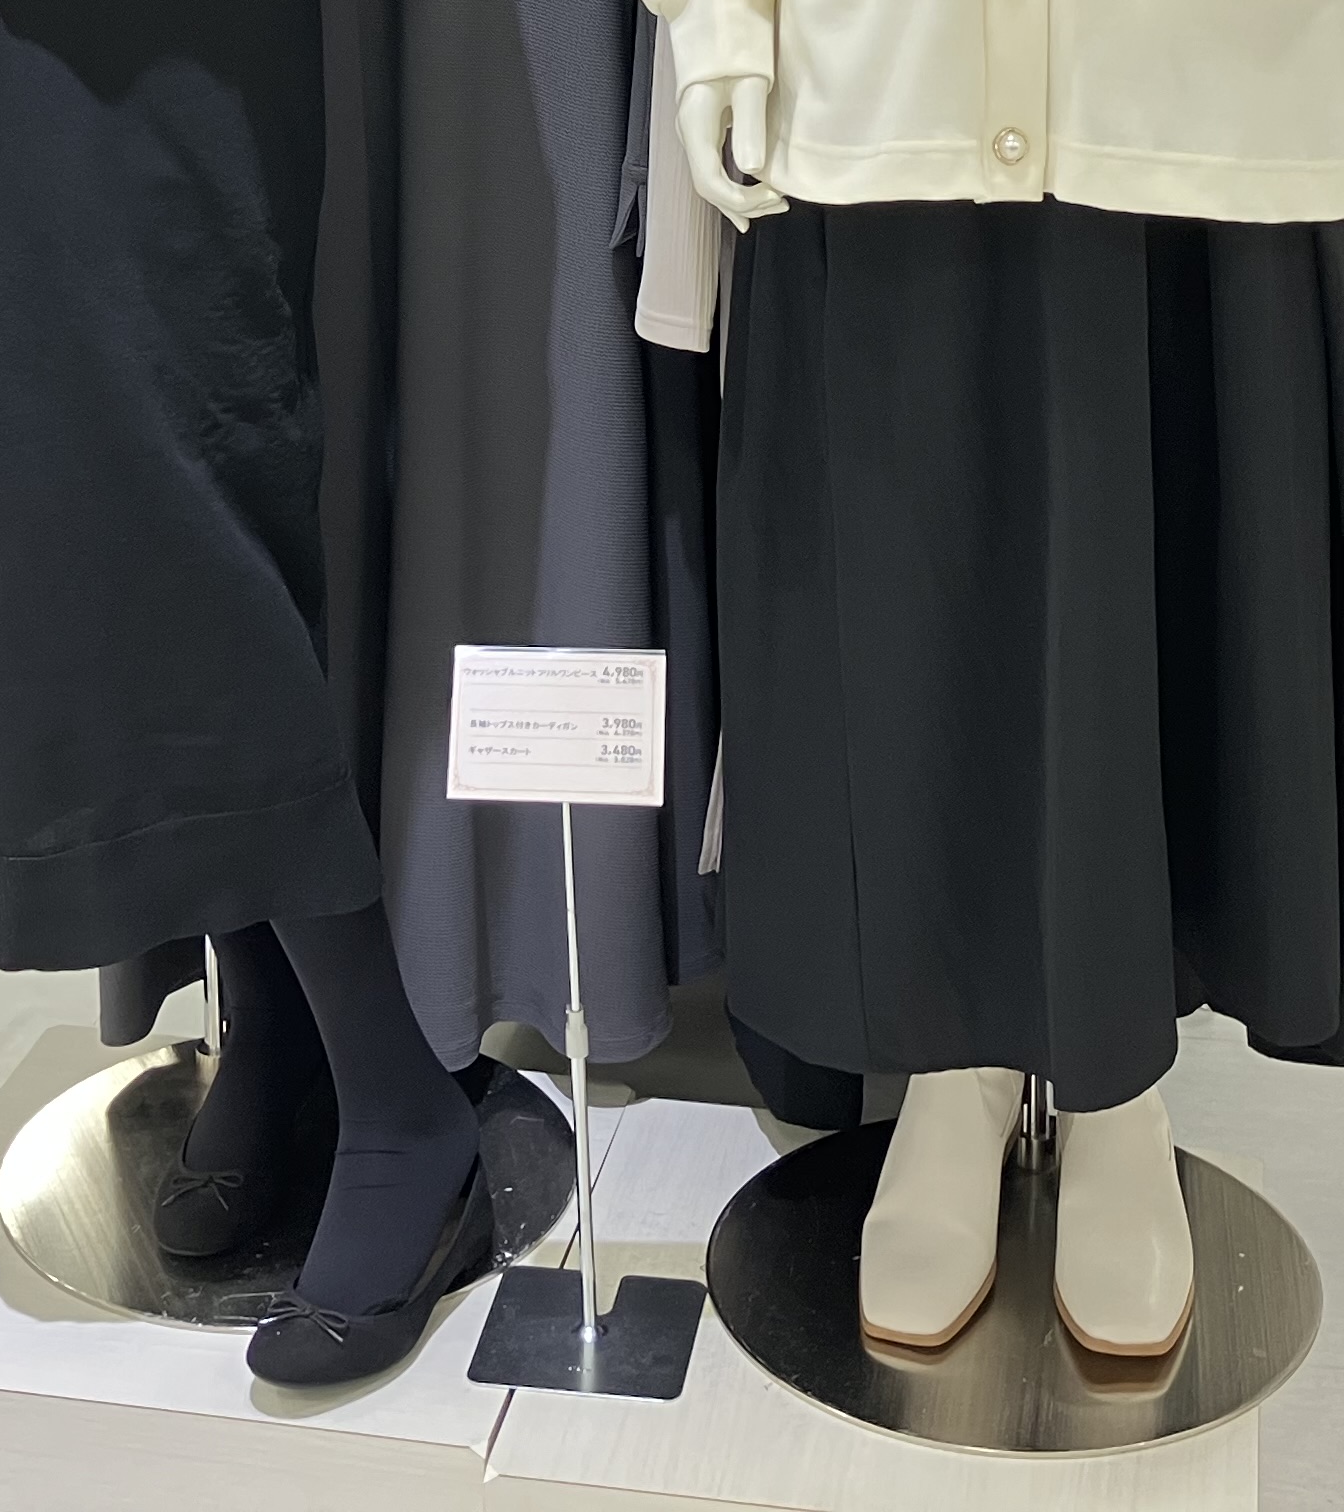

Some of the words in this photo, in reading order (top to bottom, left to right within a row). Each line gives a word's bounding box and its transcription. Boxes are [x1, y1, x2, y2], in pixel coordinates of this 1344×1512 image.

[602, 666, 644, 678] 4,980円
[602, 717, 643, 729] 3,980円
[468, 746, 532, 757] ギャザースカート
[601, 744, 642, 756] 3,480円
